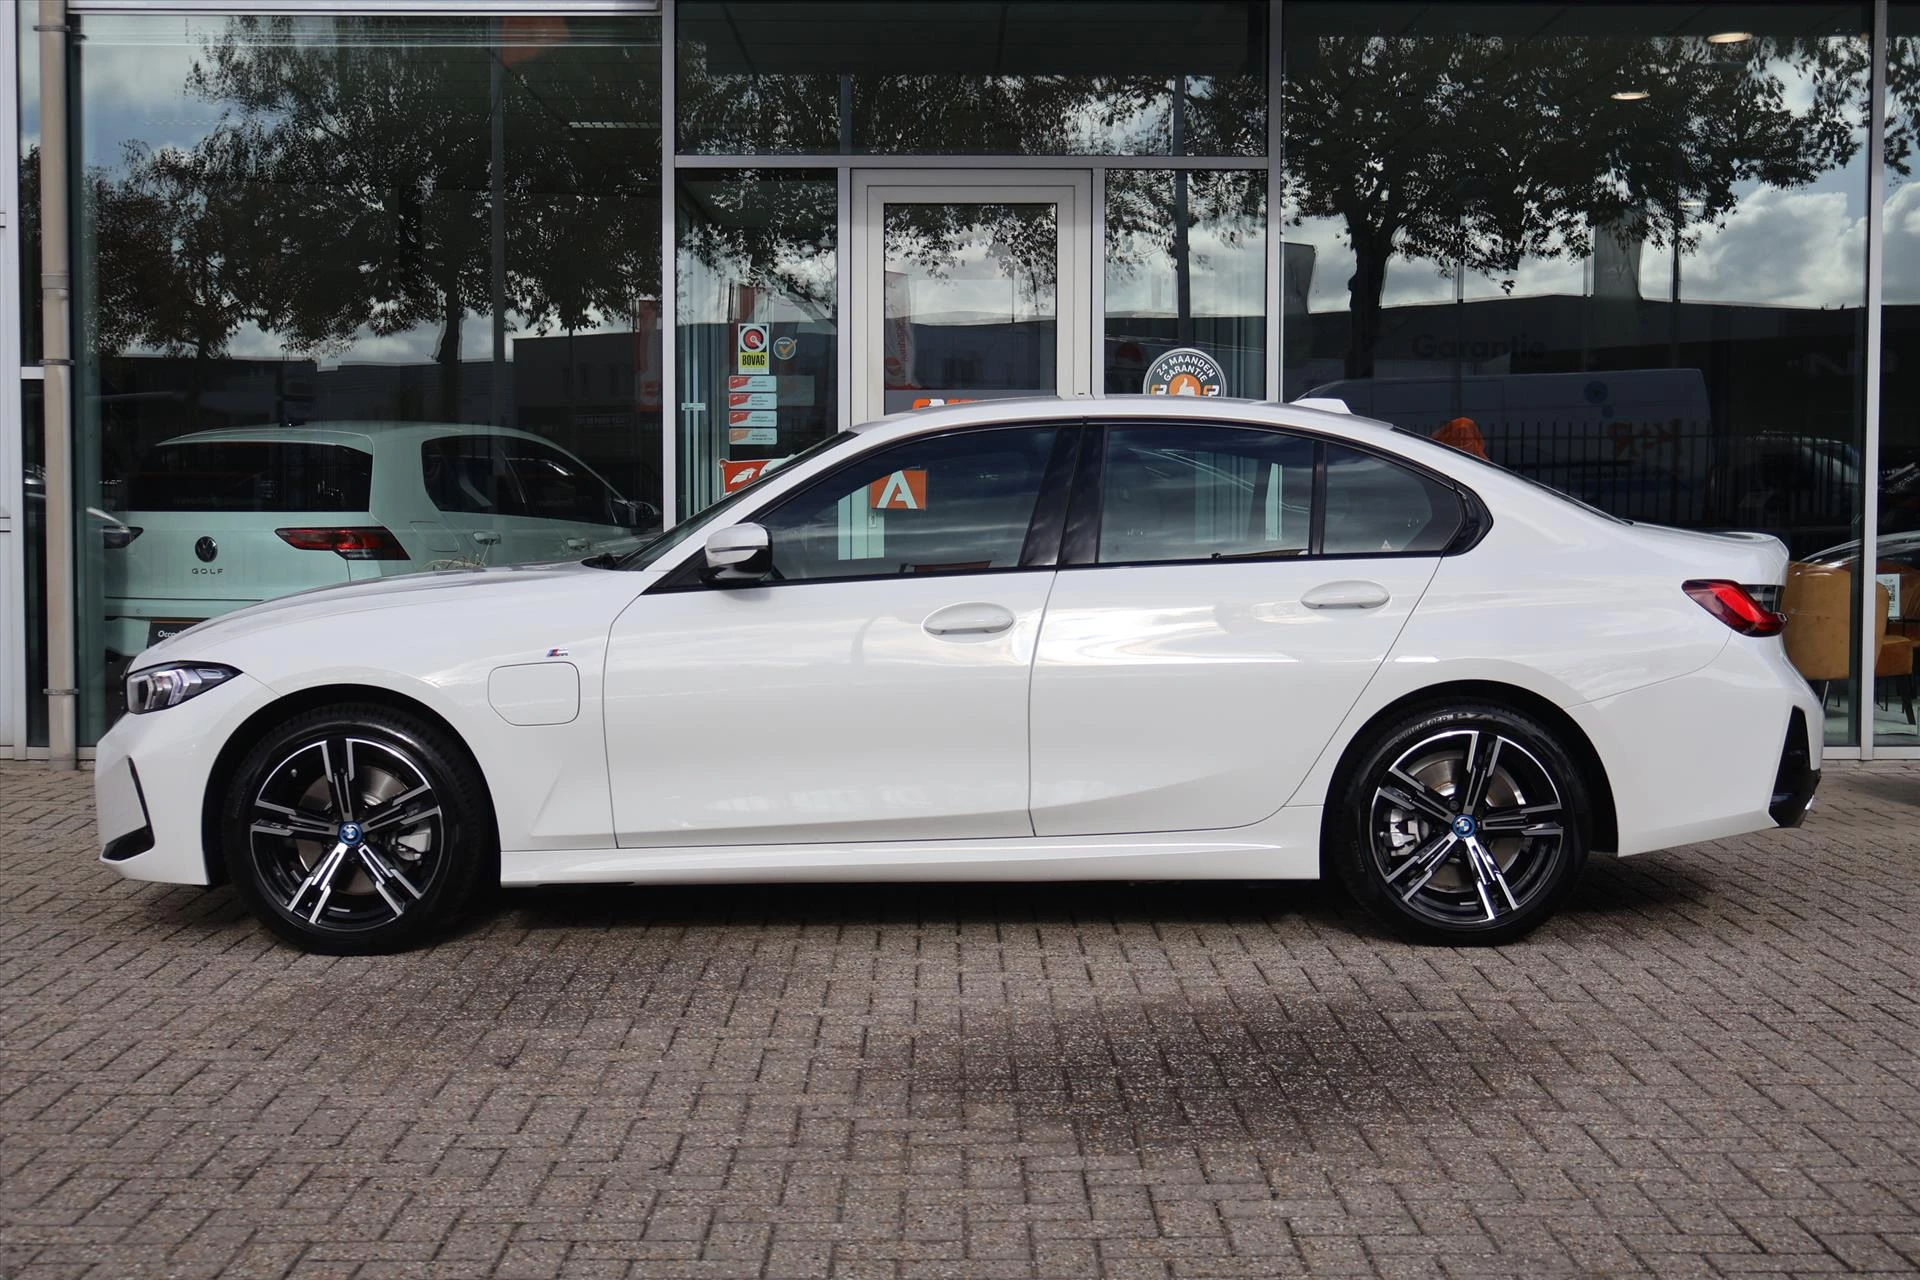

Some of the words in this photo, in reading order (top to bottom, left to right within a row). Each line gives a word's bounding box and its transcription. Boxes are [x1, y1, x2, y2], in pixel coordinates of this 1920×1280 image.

[741, 354, 765, 366] BOVAG
[1156, 363, 1168, 376] 24
[1168, 355, 1216, 378] MAANDEN
[1163, 364, 1208, 383] GARANTIE
